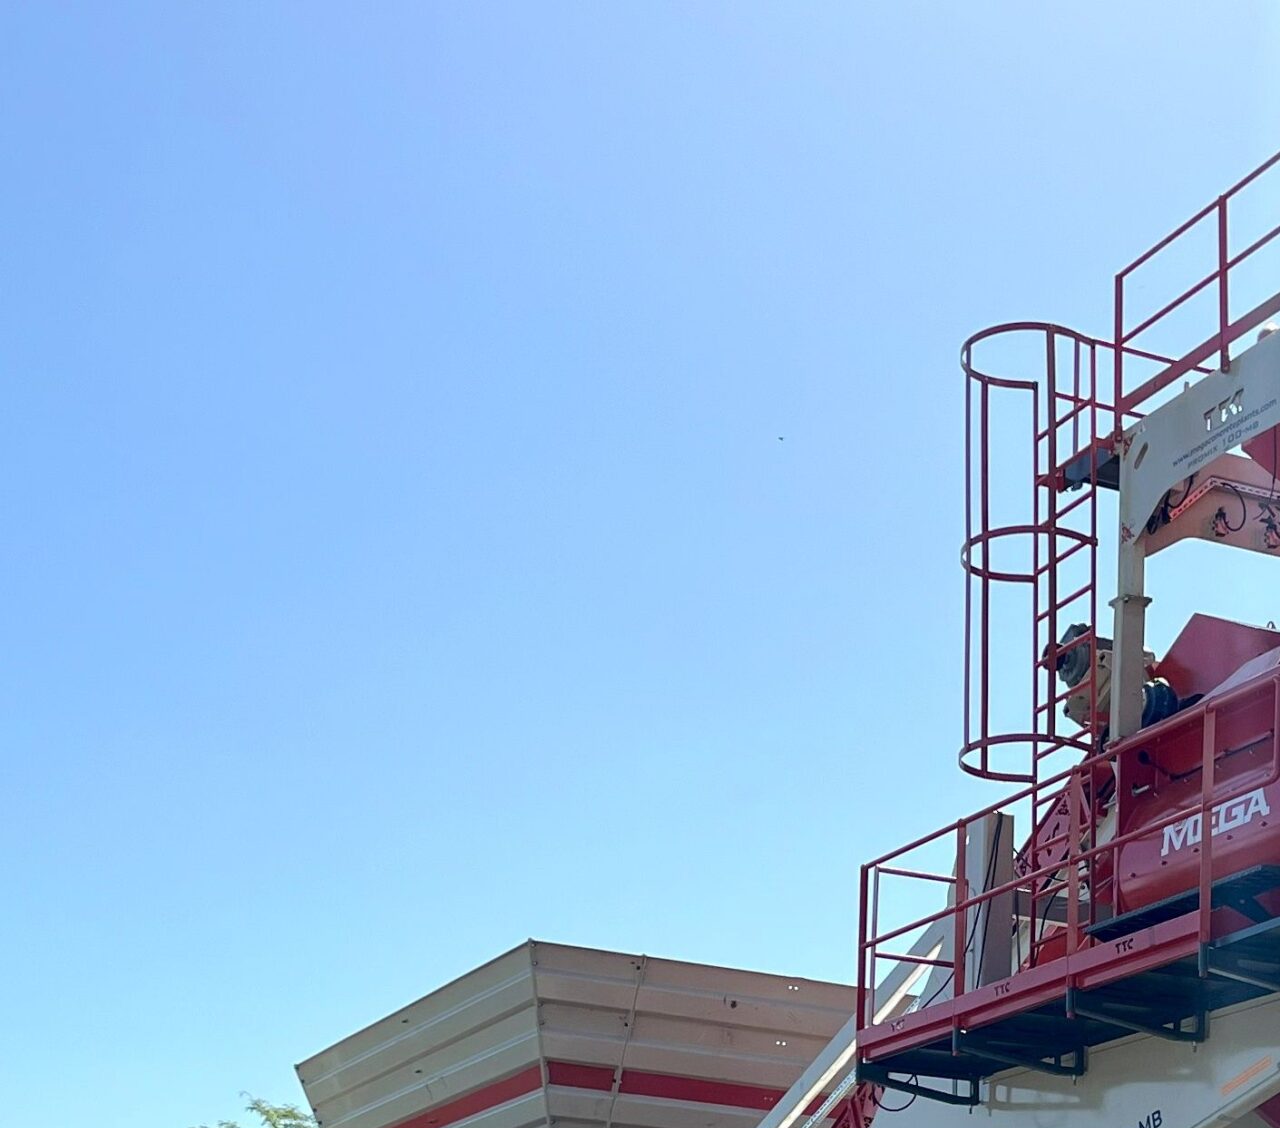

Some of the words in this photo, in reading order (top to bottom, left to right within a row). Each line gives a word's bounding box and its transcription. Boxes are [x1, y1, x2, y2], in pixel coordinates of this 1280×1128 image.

[1161, 787, 1270, 857] MEGA
[1115, 938, 1134, 954] TTC
[994, 982, 1011, 997] TTC
